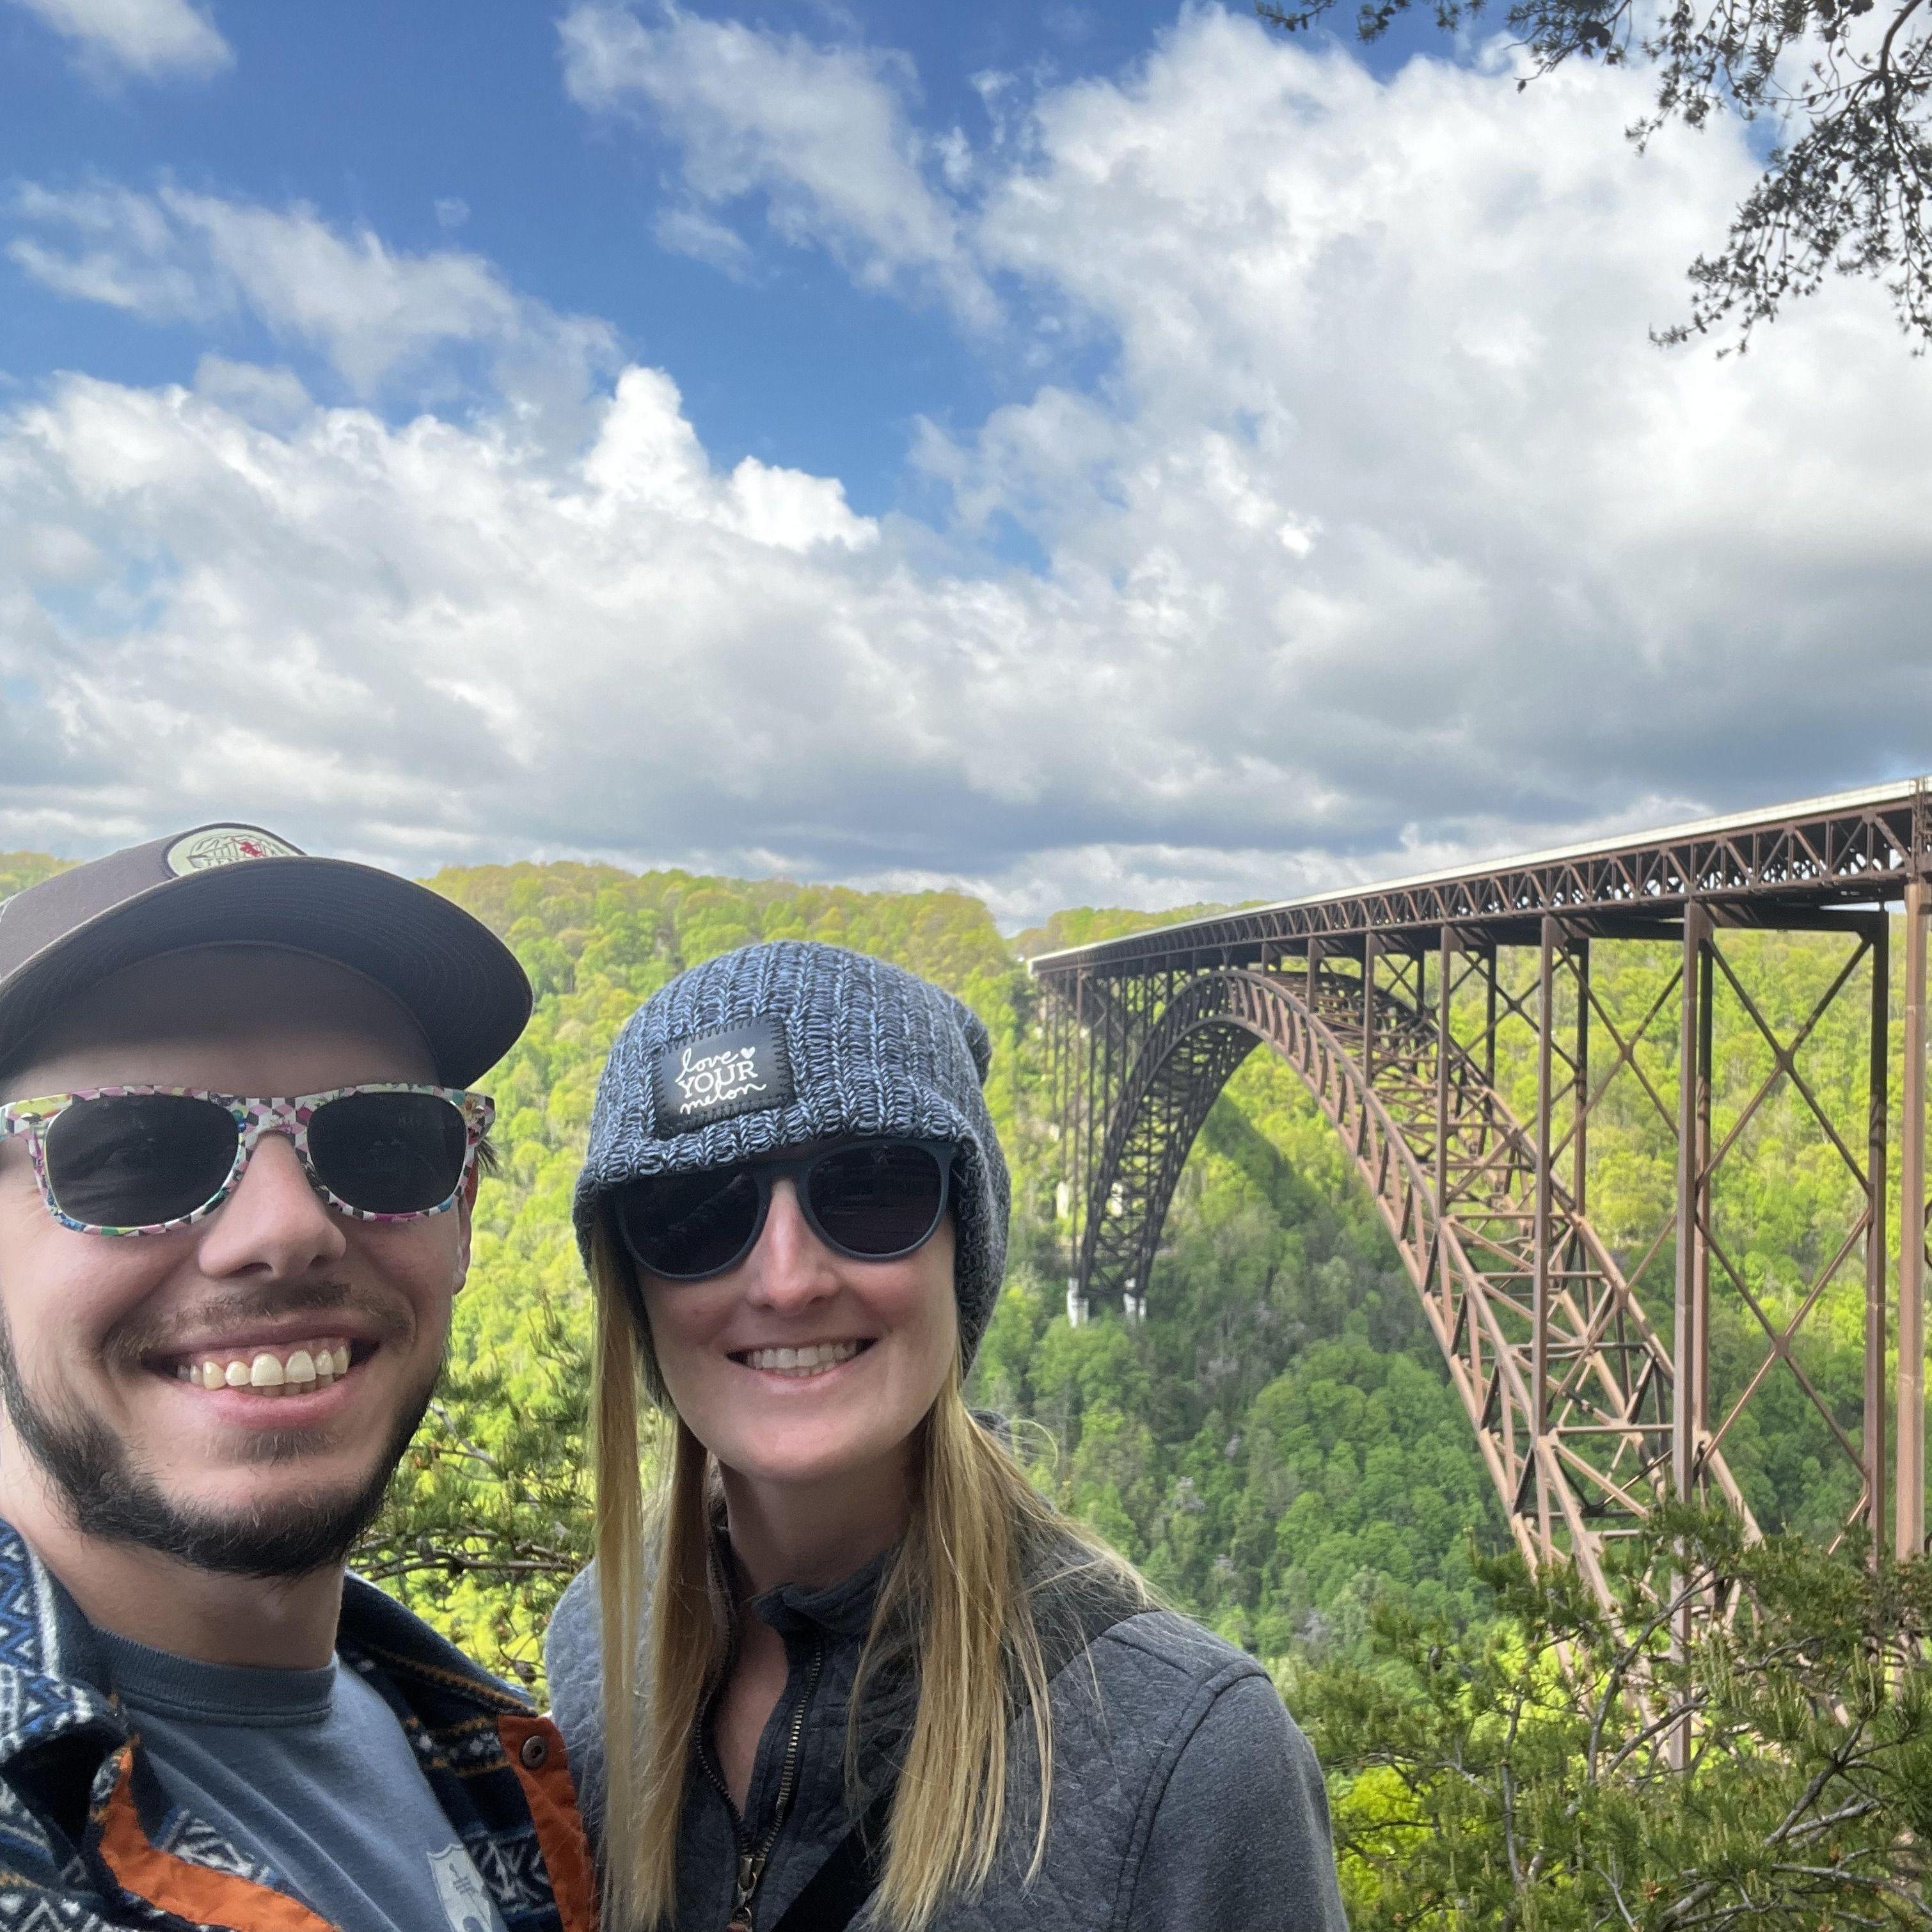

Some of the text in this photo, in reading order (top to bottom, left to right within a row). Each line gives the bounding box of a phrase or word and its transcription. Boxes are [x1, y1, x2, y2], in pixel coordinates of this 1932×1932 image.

[675, 1047, 739, 1082] love
[678, 1061, 758, 1098] YOUR
[680, 1077, 766, 1114] melon
